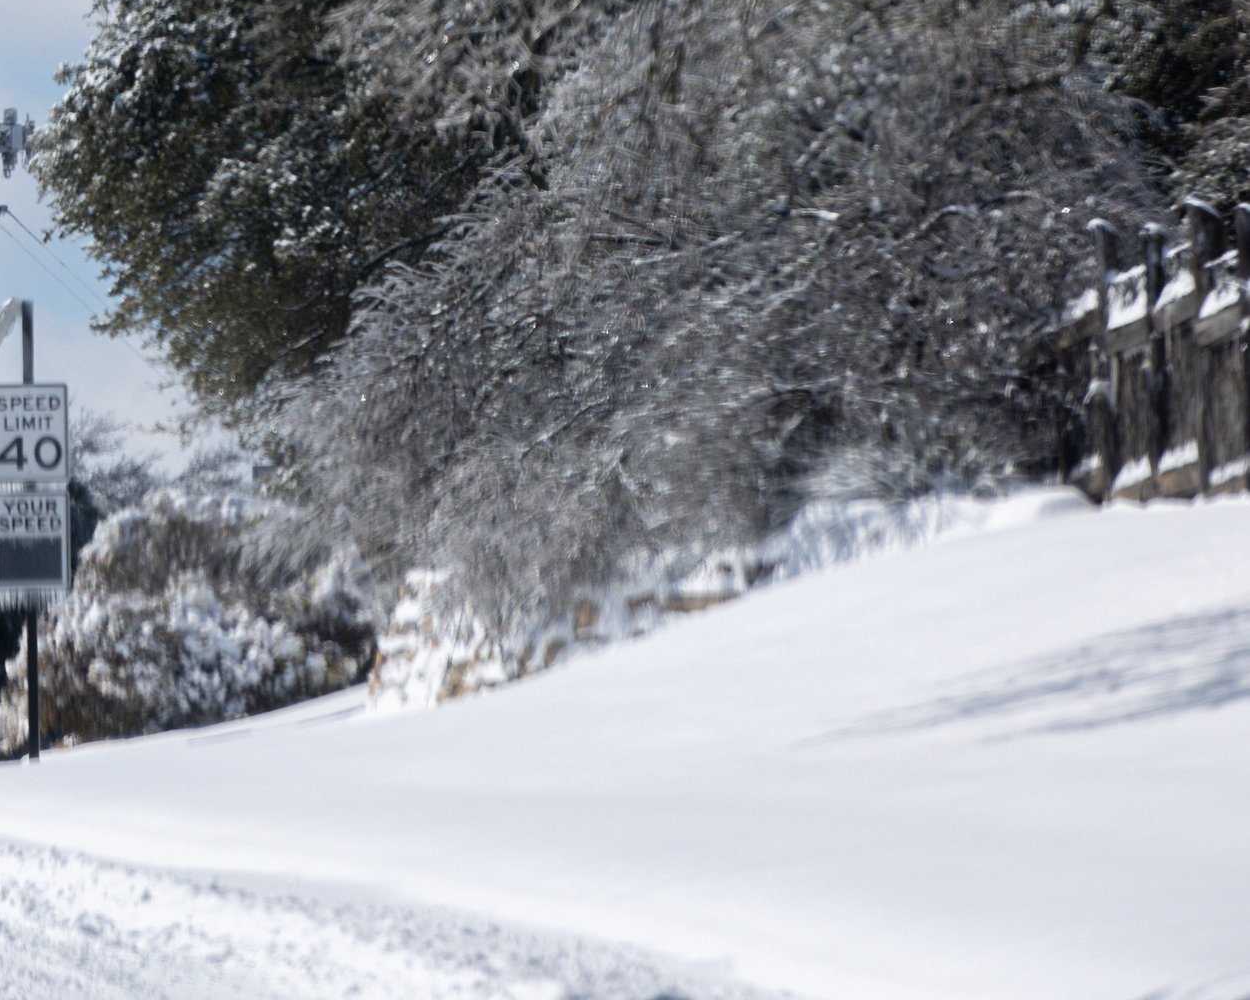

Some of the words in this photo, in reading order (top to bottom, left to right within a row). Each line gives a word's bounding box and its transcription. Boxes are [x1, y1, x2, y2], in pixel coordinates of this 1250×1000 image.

[3, 416, 54, 432] LIMIT
[3, 499, 58, 516] YOUR
[0, 517, 62, 534] SPEED
